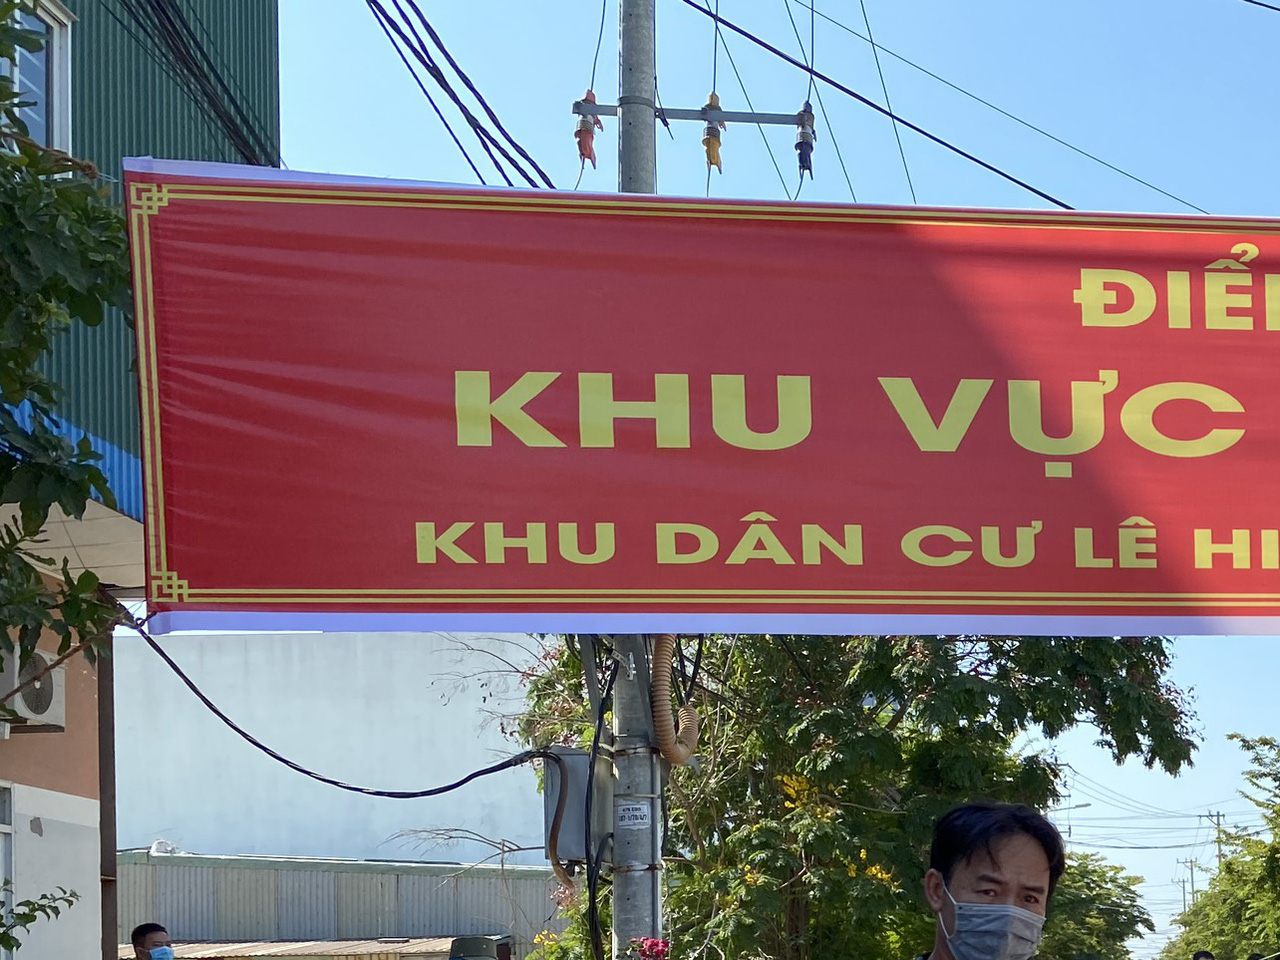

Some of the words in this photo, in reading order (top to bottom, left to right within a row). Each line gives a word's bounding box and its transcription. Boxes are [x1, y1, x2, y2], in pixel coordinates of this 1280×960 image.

[454, 370, 812, 451] KHU
[877, 368, 1245, 479] VỰC
[414, 521, 616, 565] KHU
[655, 511, 864, 566] DÂN
[900, 520, 1043, 568] CƯ
[1074, 515, 1158, 569] LÊ
